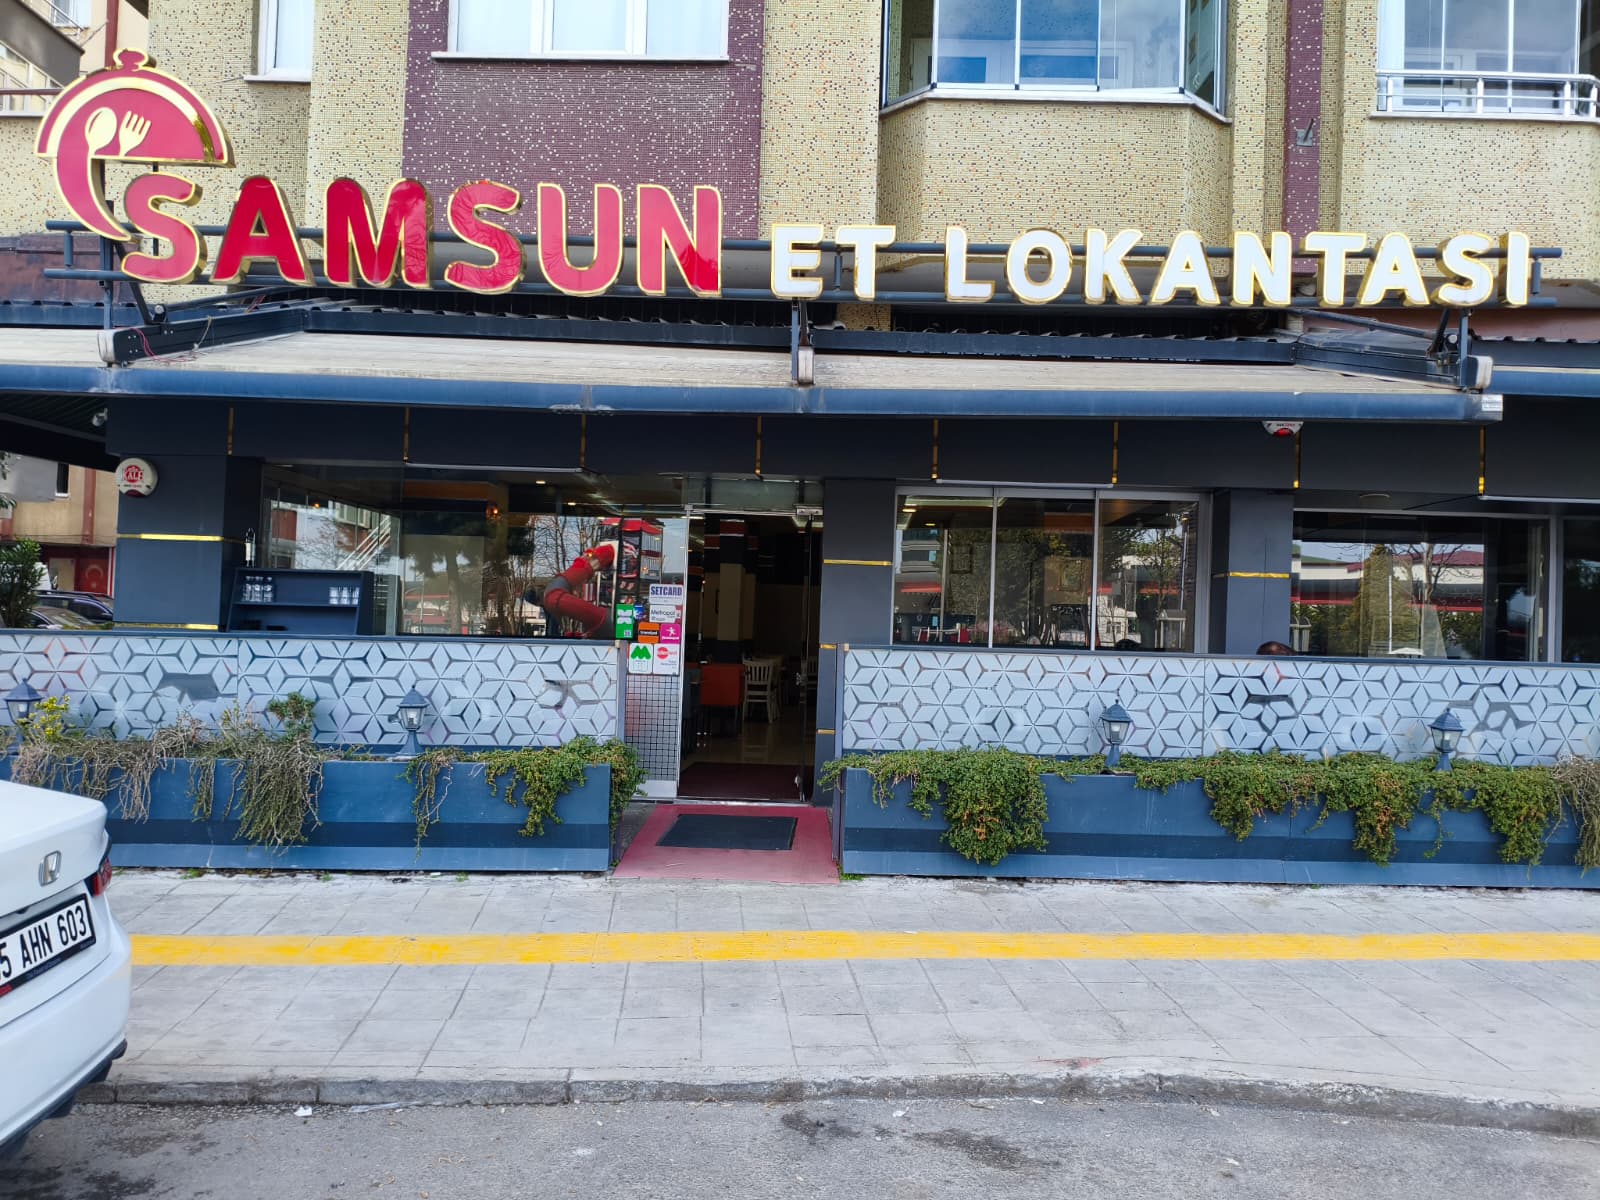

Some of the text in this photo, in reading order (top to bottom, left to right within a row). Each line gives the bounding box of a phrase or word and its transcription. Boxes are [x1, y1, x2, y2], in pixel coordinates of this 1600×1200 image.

[120, 173, 1531, 307] SAMSUN ET LOKANTASI
[650, 586, 682, 596] SETCARD
[20, 922, 53, 968] AHN
[57, 905, 87, 946] 603
